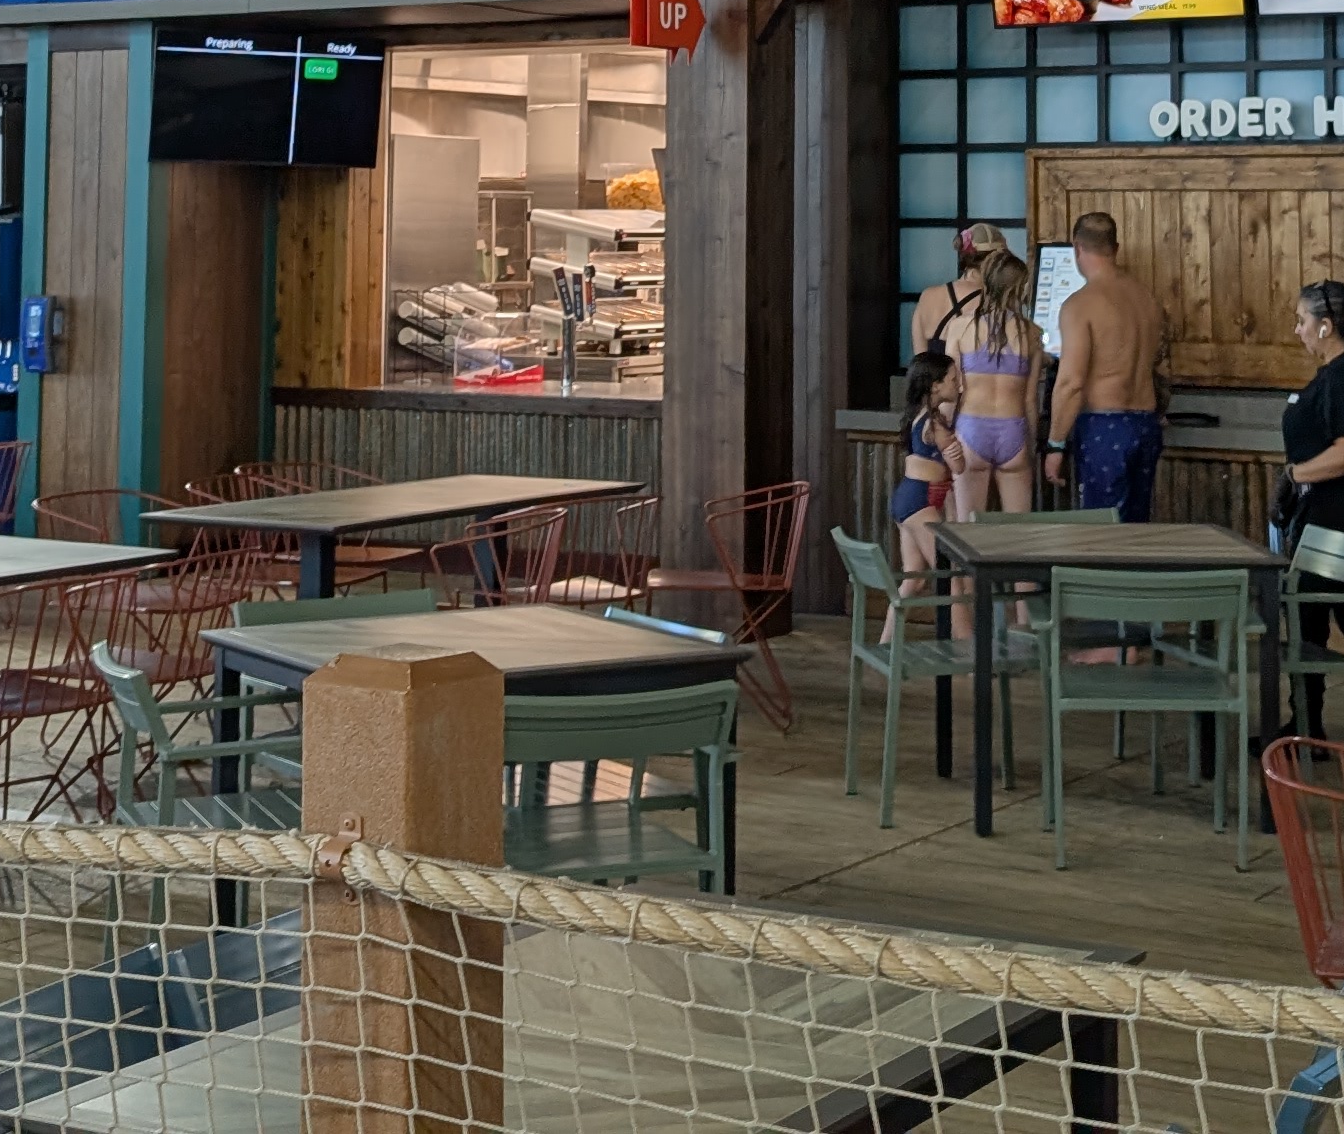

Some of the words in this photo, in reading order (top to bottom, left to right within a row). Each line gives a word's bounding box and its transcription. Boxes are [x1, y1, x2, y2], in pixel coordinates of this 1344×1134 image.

[659, 1, 687, 30] UP
[205, 36, 254, 51] Preparing
[327, 42, 357, 57] Ready
[1149, 96, 1294, 138] ORDER
